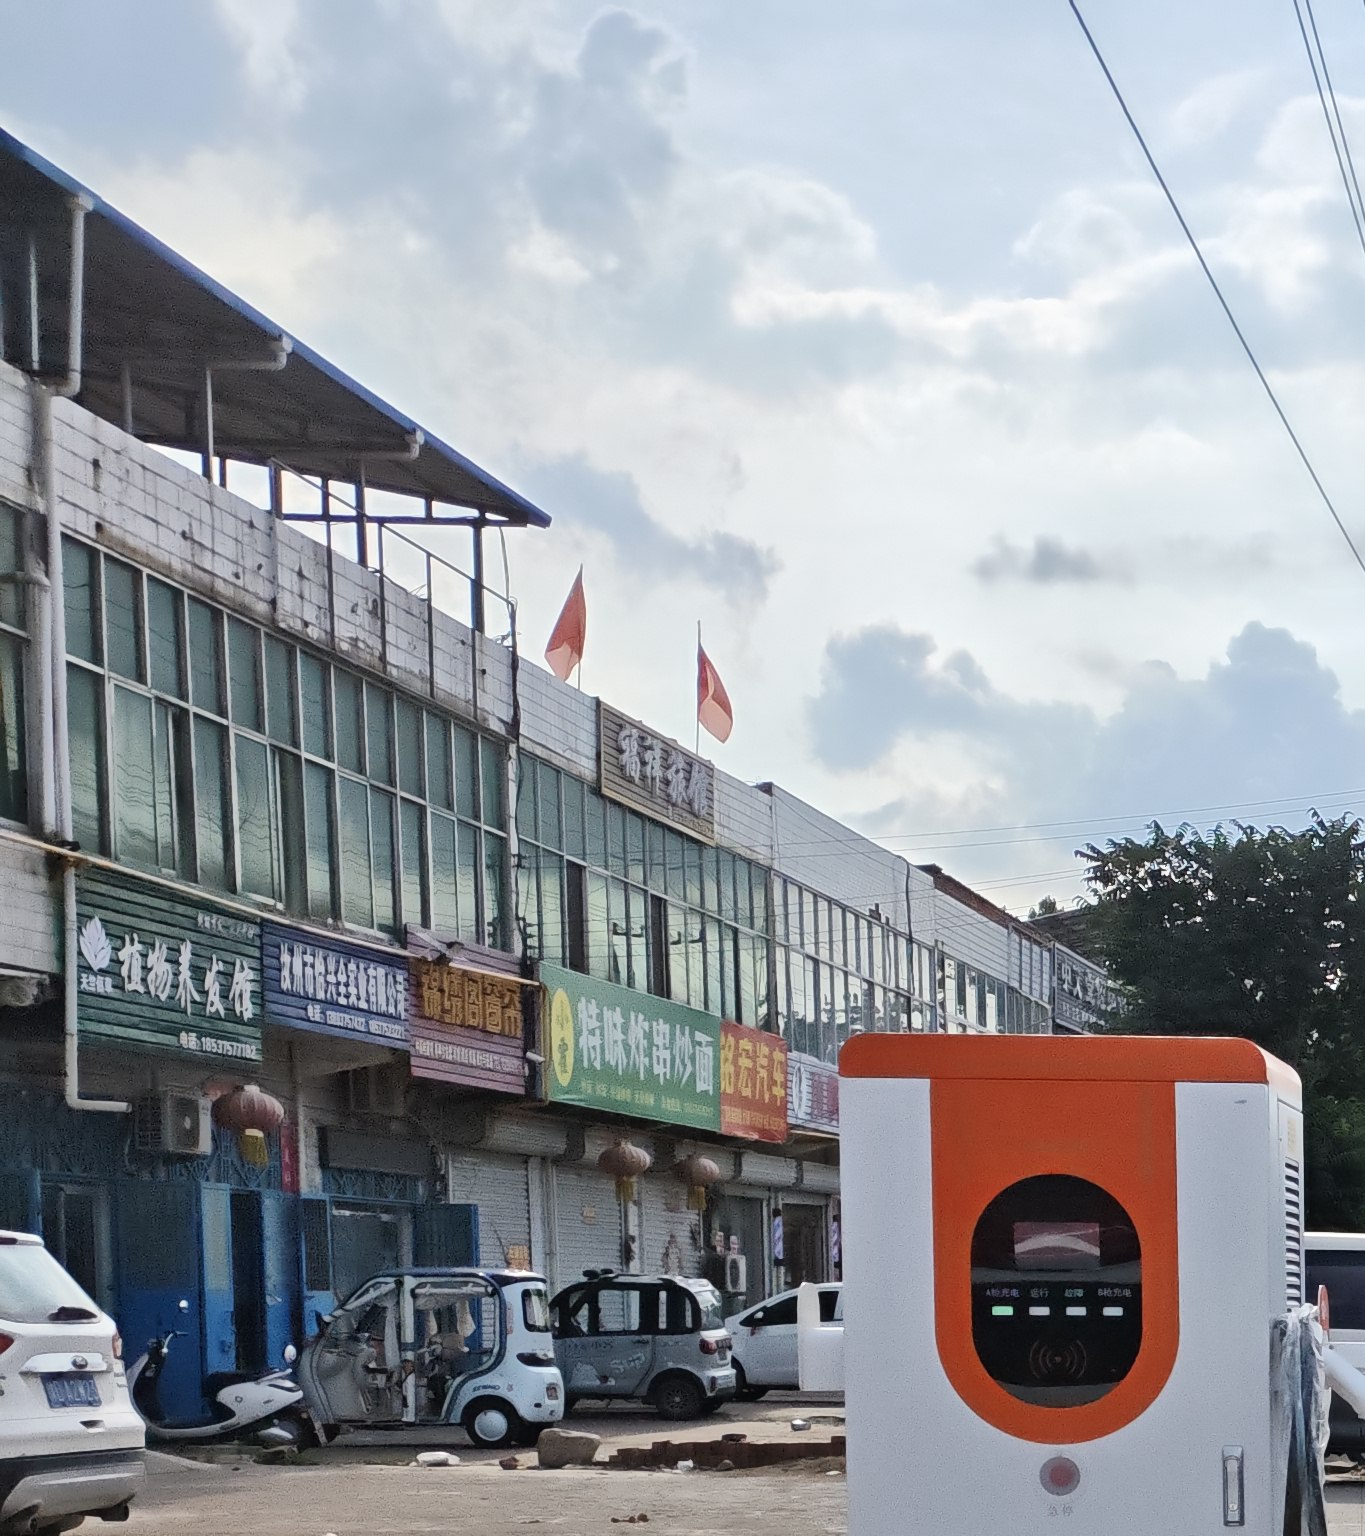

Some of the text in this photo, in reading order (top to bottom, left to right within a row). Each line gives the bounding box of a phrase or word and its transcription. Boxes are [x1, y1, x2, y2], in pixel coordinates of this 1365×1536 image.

[117, 932, 255, 1022] 植物养发馆
[578, 997, 714, 1096] 特味炸串炒面
